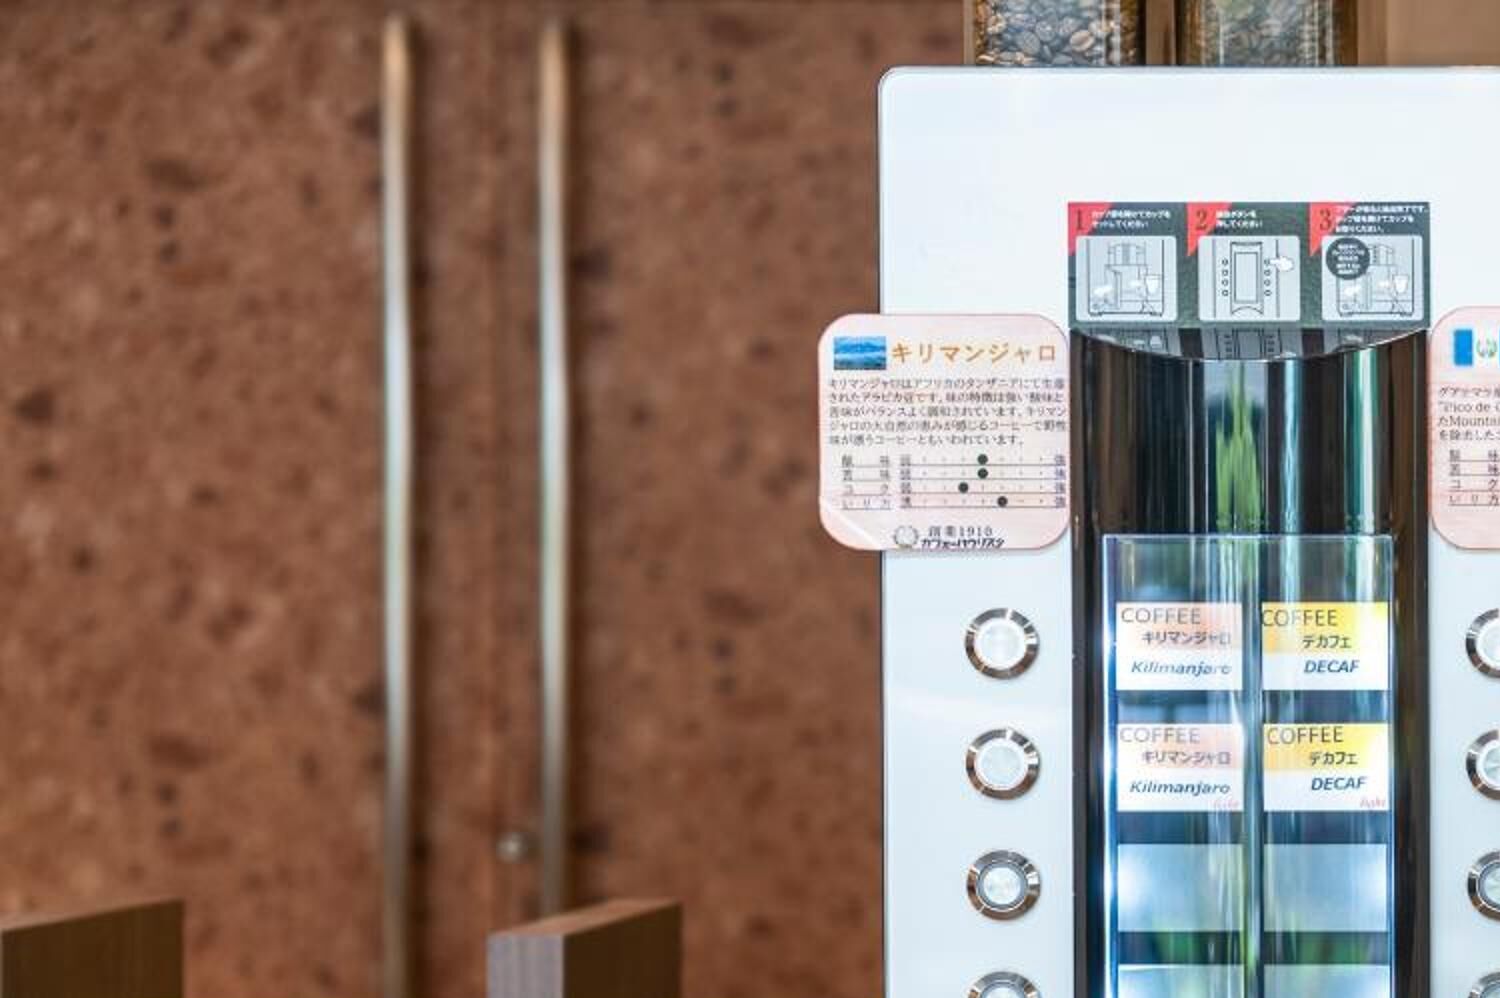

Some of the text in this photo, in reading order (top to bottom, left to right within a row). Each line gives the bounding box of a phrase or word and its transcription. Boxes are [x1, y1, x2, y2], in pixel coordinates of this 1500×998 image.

[1075, 210, 1085, 230] 1
[1195, 209, 1207, 231] 2
[1319, 209, 1331, 231] 3
[891, 342, 1056, 364] キリマンジャロ
[1121, 607, 1201, 625] COFFEE
[1262, 609, 1338, 627] COFFEE
[1141, 631, 1232, 648] キリマンジャロ
[1302, 634, 1352, 650] デカフェ
[1131, 661, 1232, 677] Kilimanjaro
[1304, 659, 1360, 674] DECAF
[1119, 726, 1201, 743] COFFEE
[1266, 726, 1344, 745] COFFEE
[1141, 750, 1232, 766] キリマンジャロ
[1309, 751, 1358, 766] デカフェ
[1130, 780, 1230, 796] Kilimanjaro
[1311, 777, 1368, 791] DECAF
